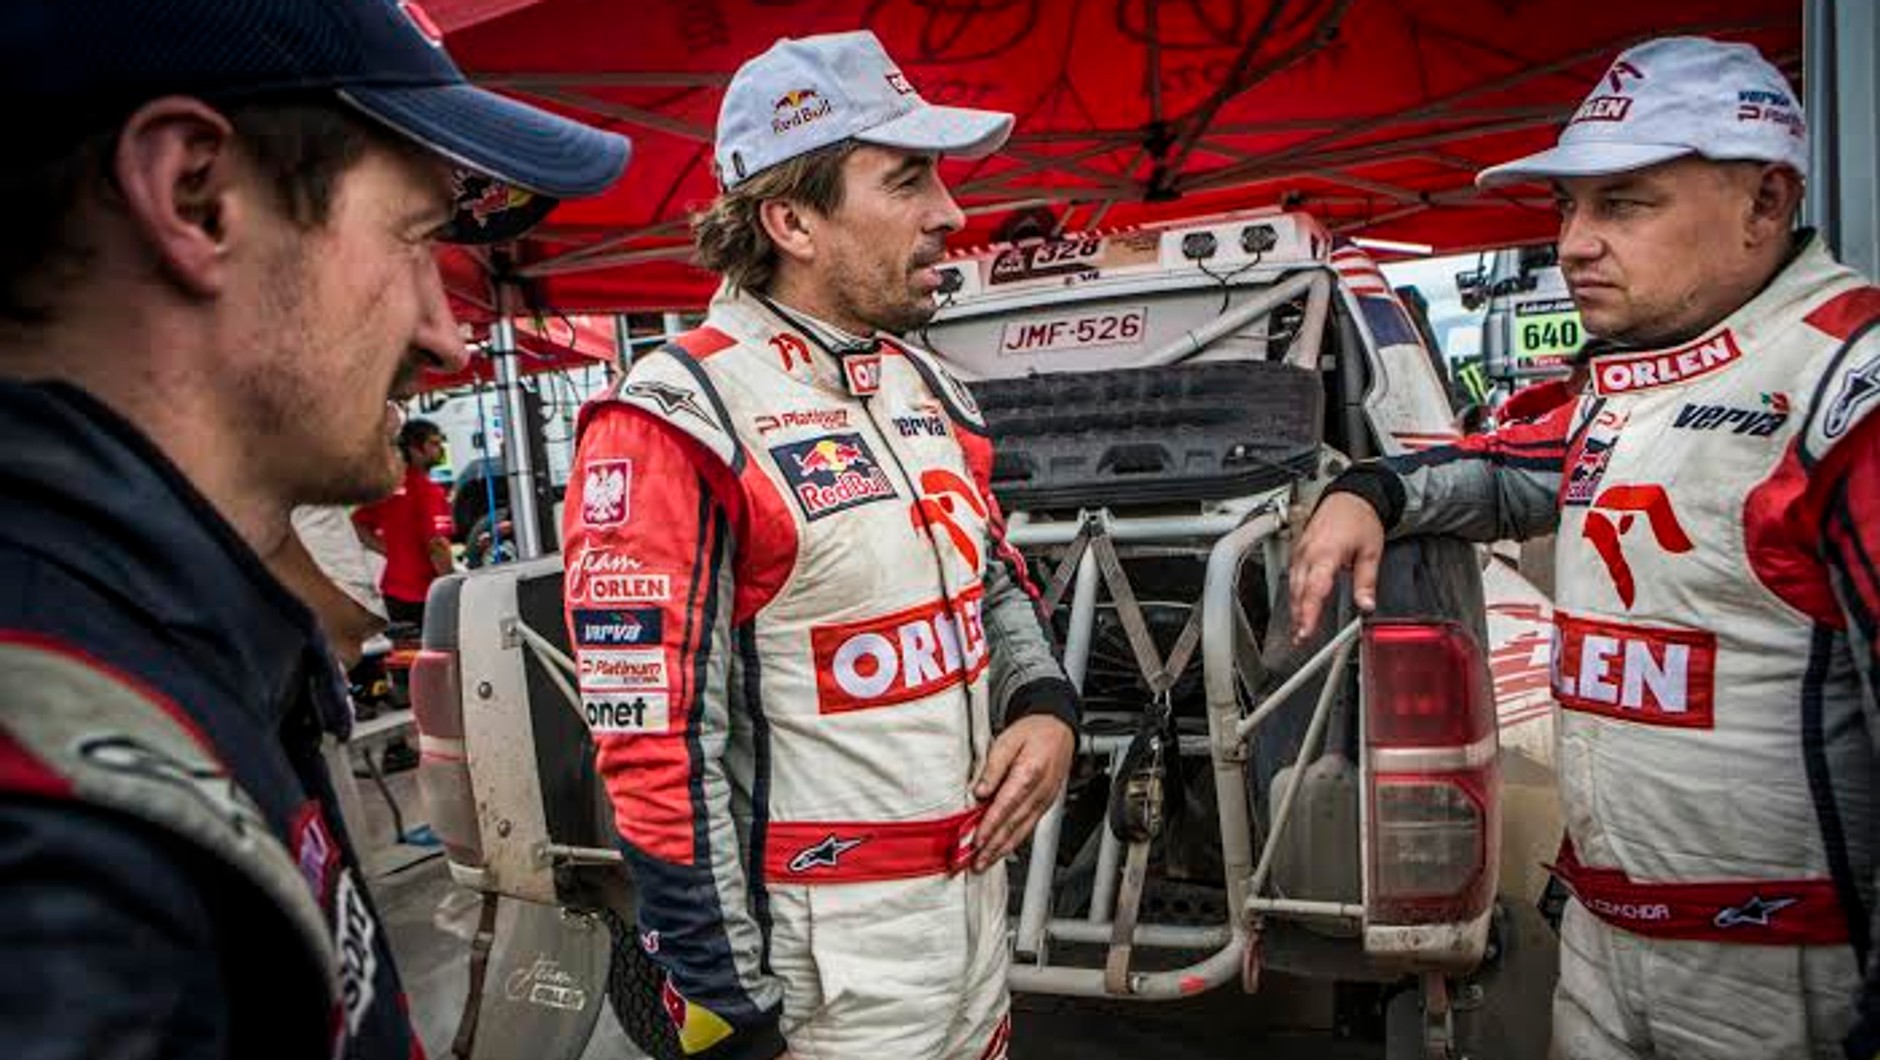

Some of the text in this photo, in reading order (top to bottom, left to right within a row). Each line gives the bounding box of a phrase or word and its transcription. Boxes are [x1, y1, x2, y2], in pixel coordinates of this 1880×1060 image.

[1524, 320, 1578, 350] 640
[1602, 336, 1733, 390] ORLEN
[593, 579, 665, 597] ORLEN
